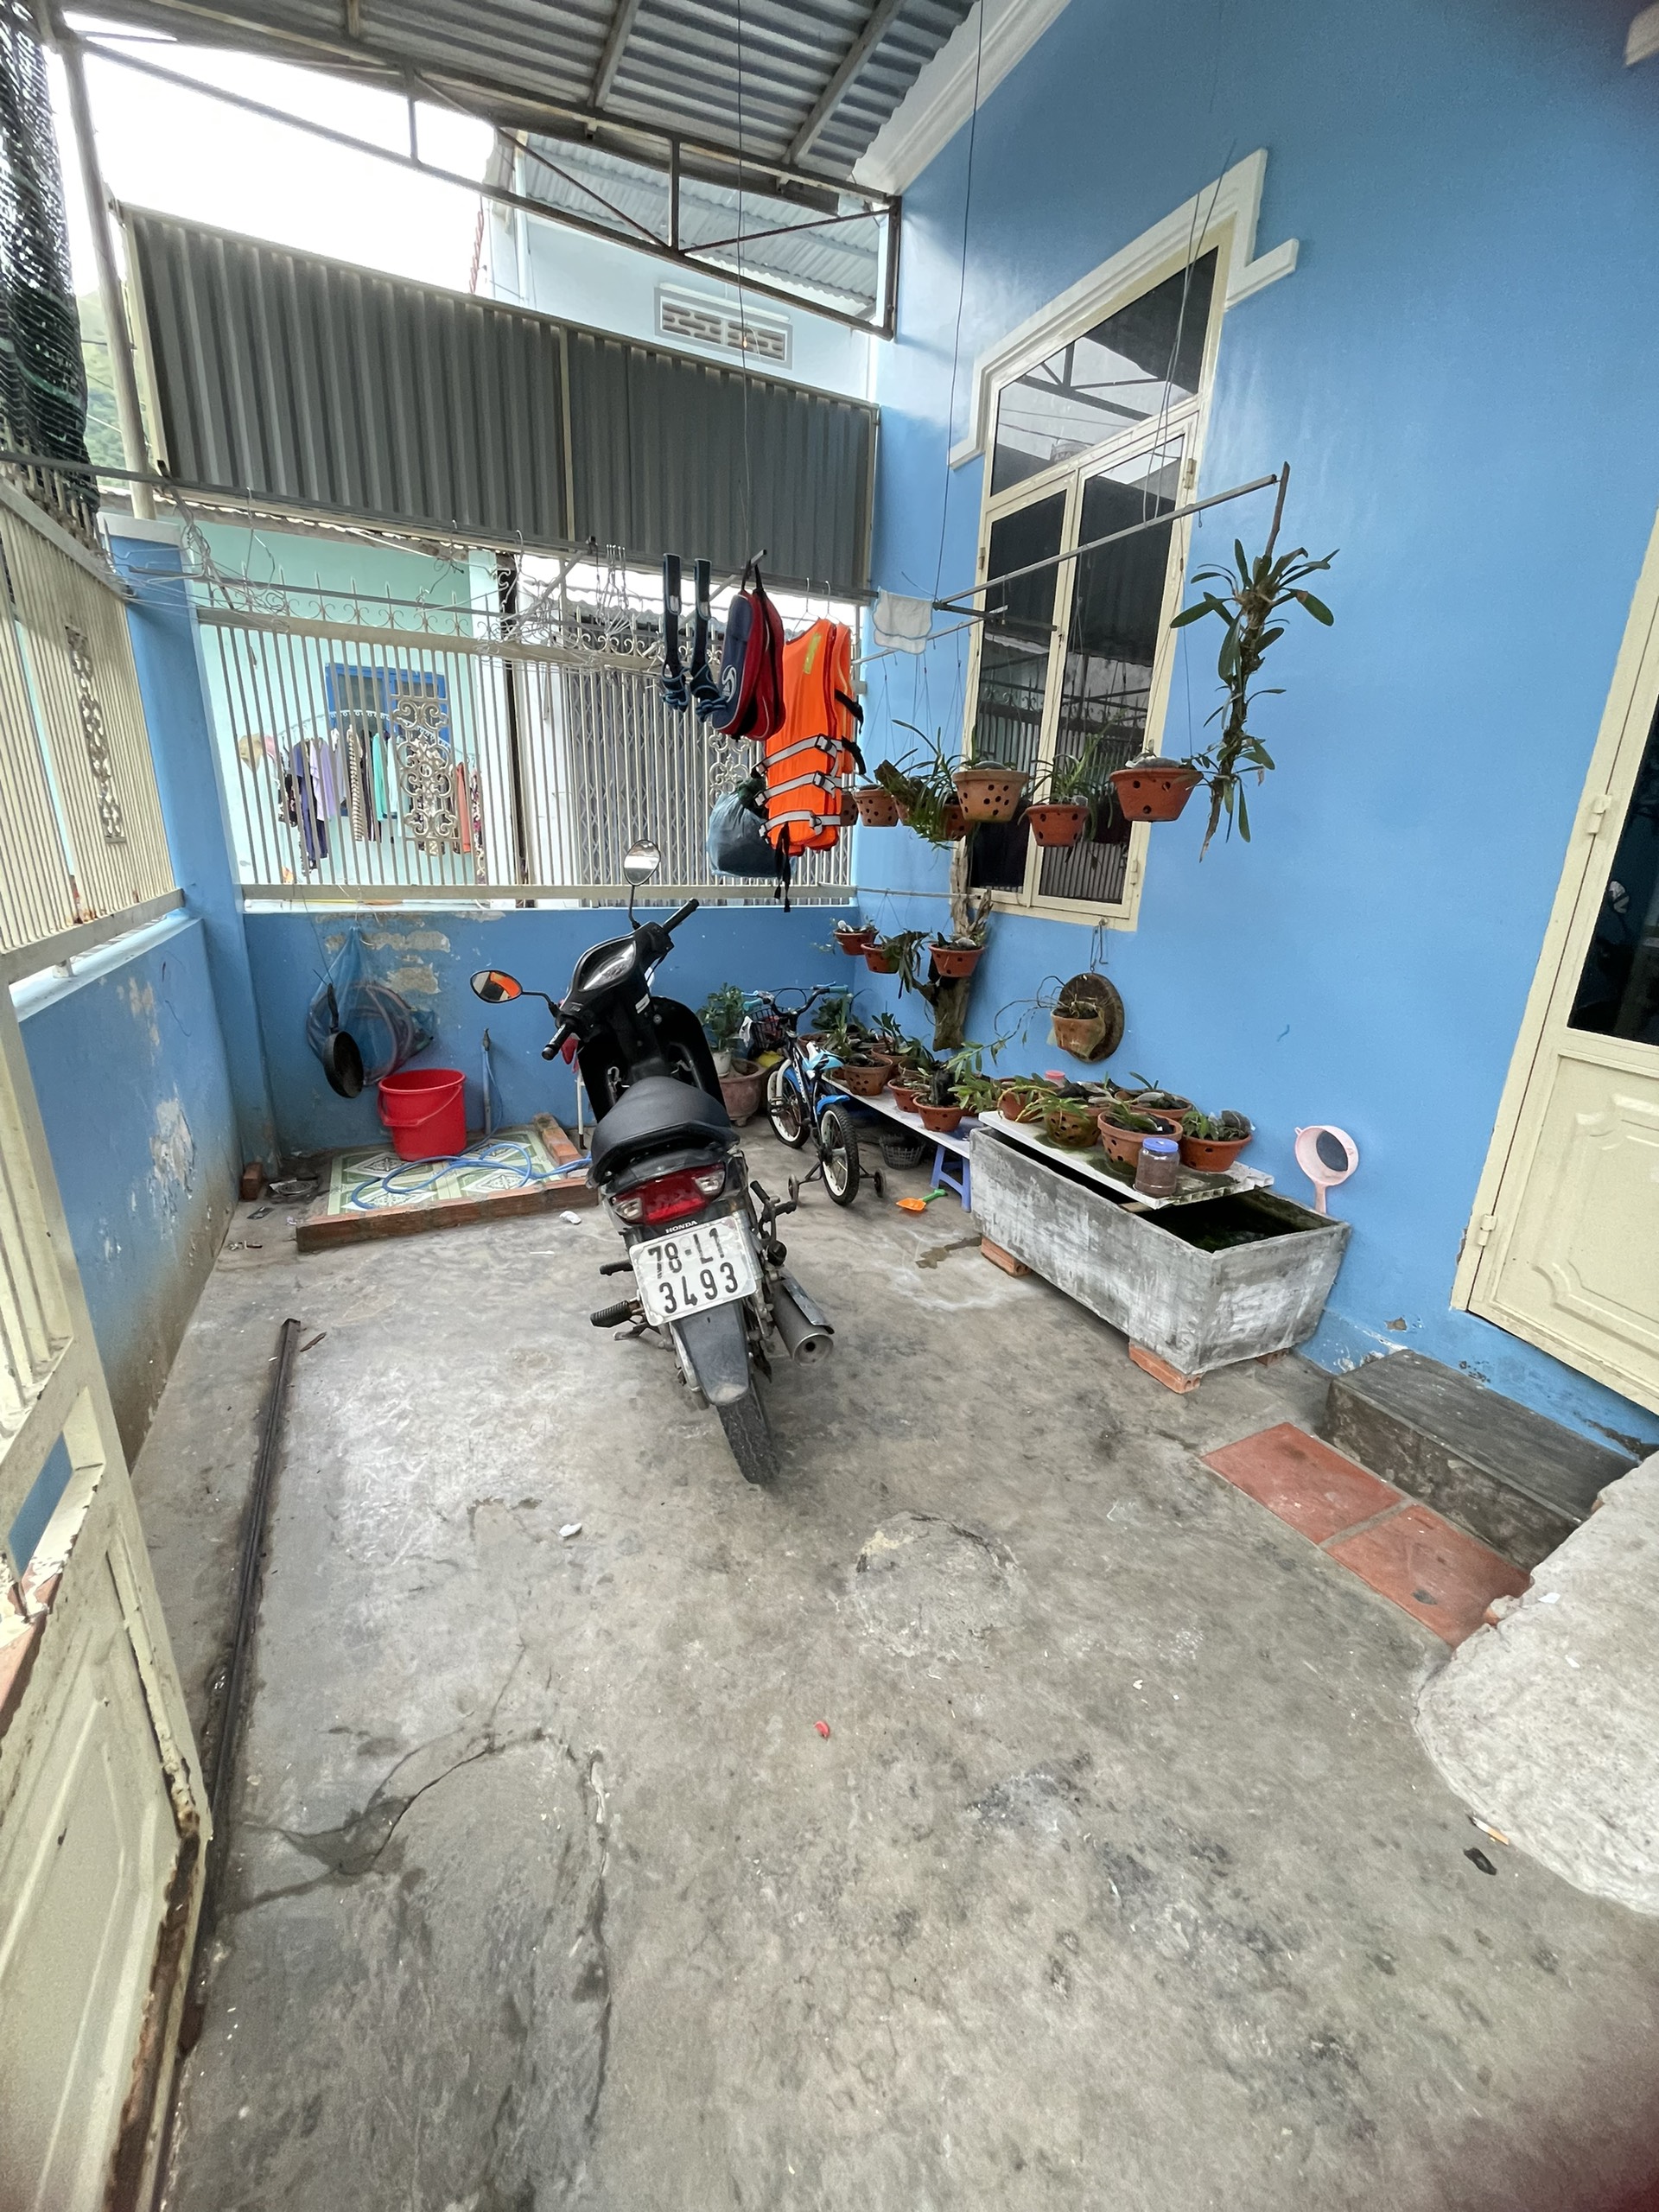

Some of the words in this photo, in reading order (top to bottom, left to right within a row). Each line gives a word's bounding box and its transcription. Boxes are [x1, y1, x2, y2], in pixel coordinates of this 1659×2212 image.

[665, 1220, 697, 1233] HONDA
[648, 1228, 725, 1279] 78-L1
[659, 1262, 738, 1313] 3493
